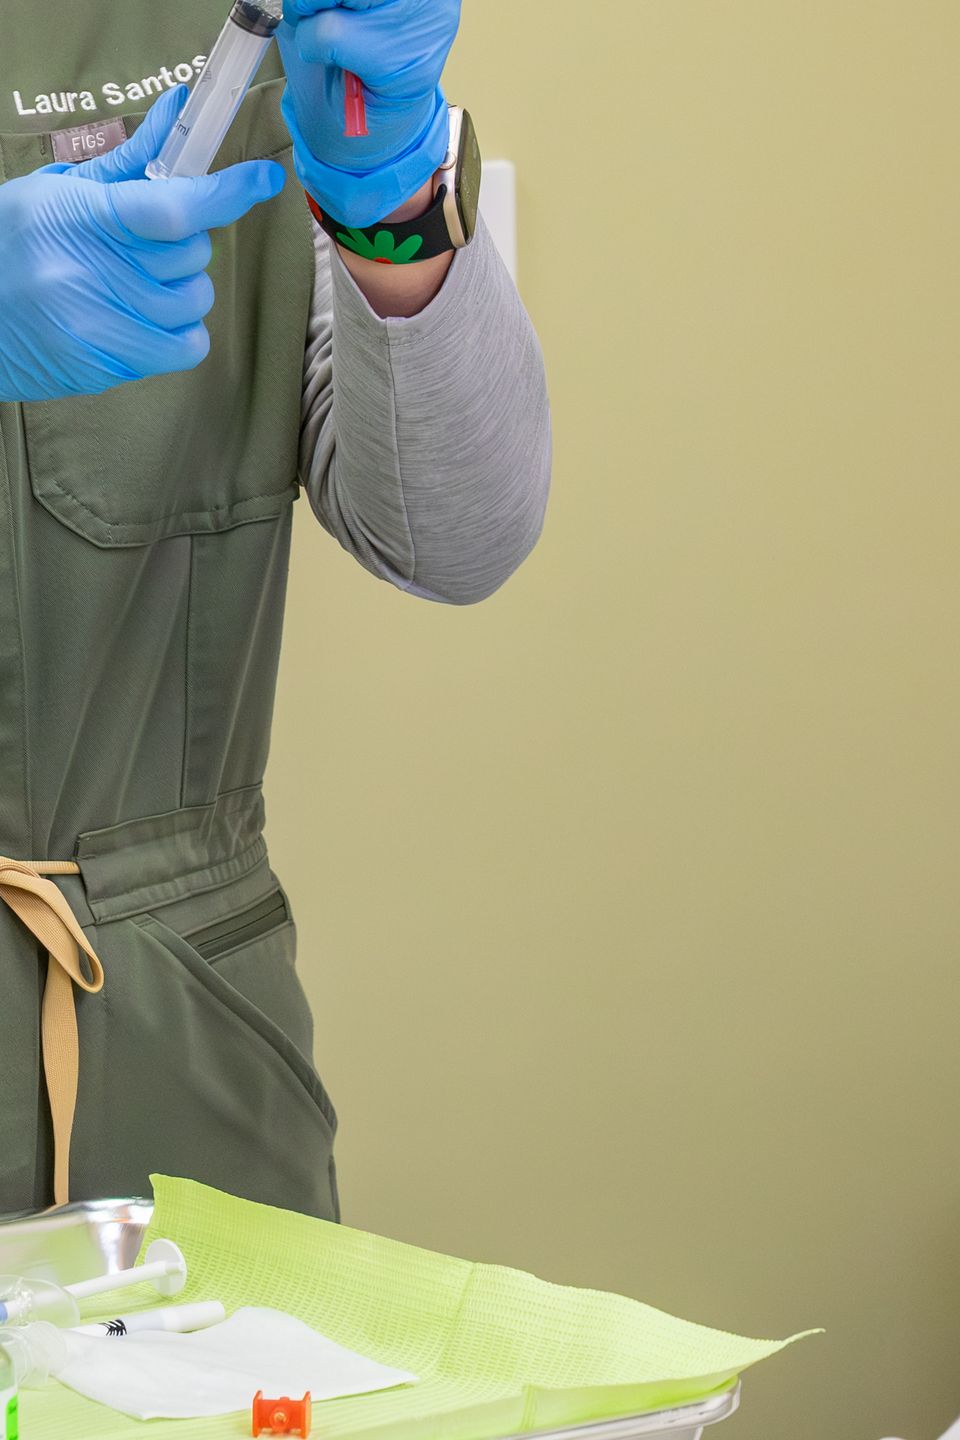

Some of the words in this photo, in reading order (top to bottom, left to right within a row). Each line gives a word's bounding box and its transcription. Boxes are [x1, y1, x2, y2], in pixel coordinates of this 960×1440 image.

[12, 90, 96, 116] Laura
[101, 54, 208, 106] Santos
[71, 131, 106, 152] FIGS
